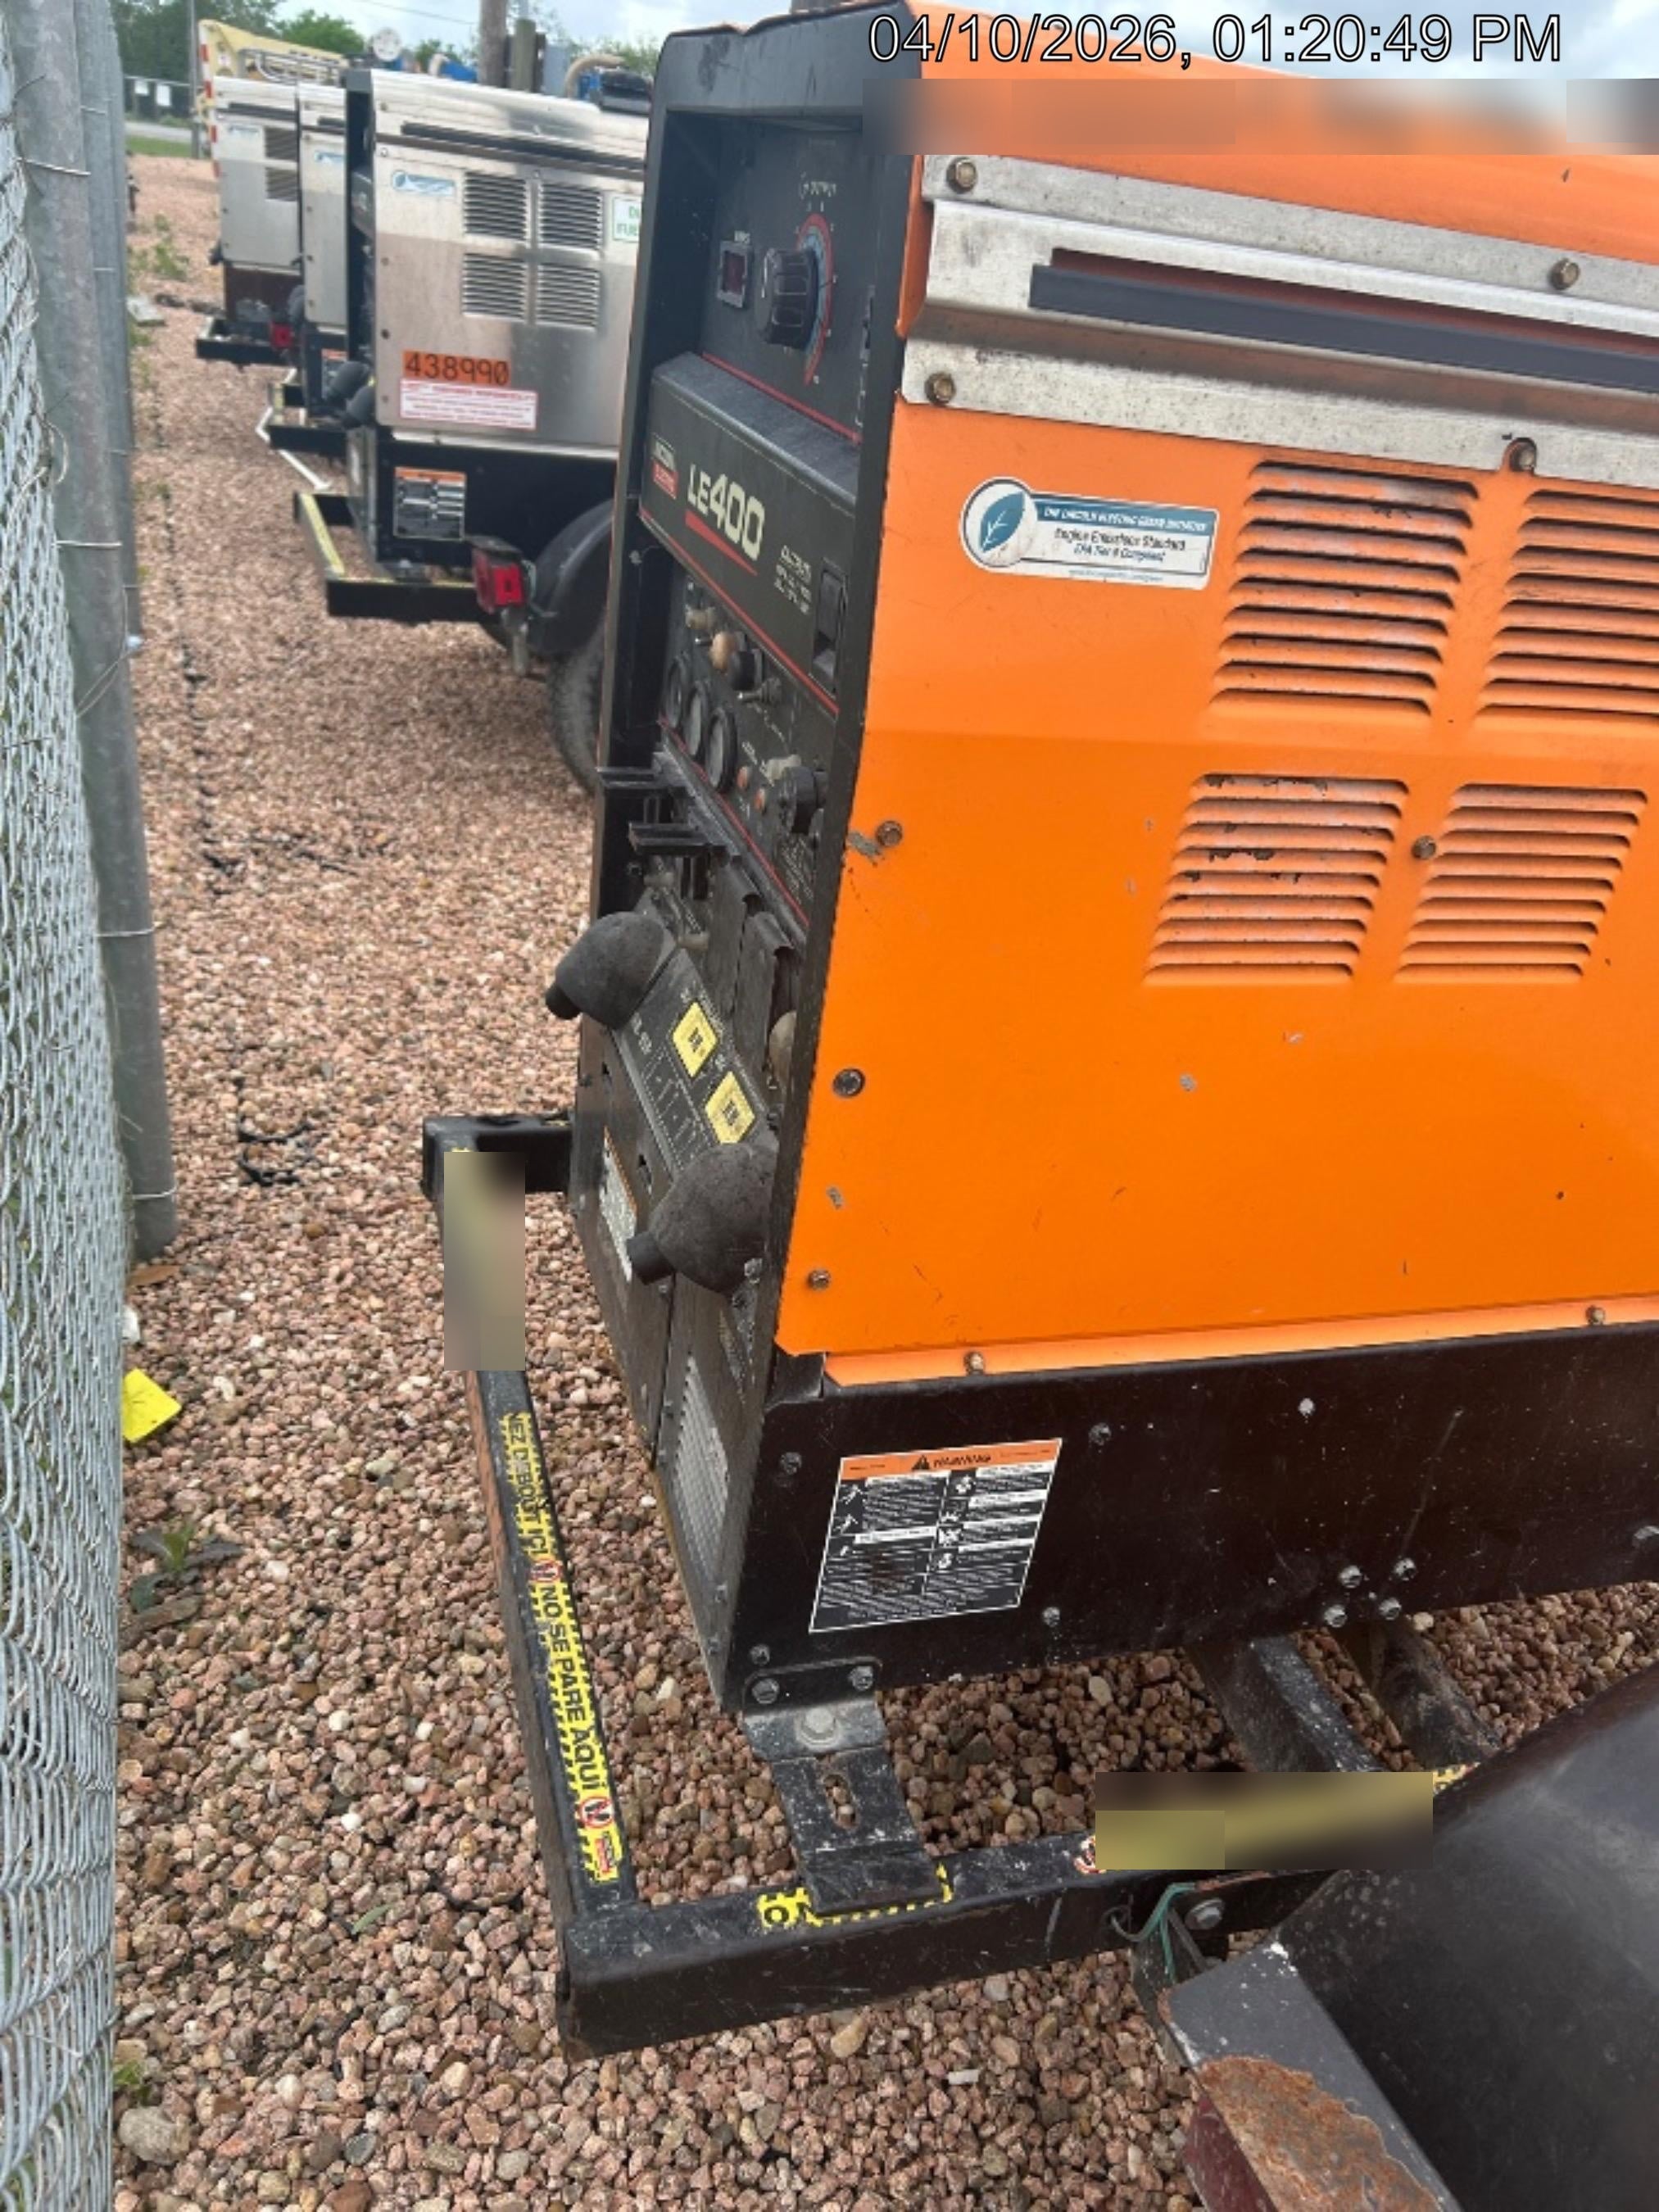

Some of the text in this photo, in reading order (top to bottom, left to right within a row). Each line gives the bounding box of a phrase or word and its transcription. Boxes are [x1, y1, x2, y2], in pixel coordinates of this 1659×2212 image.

[406, 351, 510, 386] 438990
[687, 464, 765, 560] LE400
[539, 1585, 563, 1619] NO
[549, 1623, 571, 1653] SE
[556, 1657, 587, 1723] PARE
